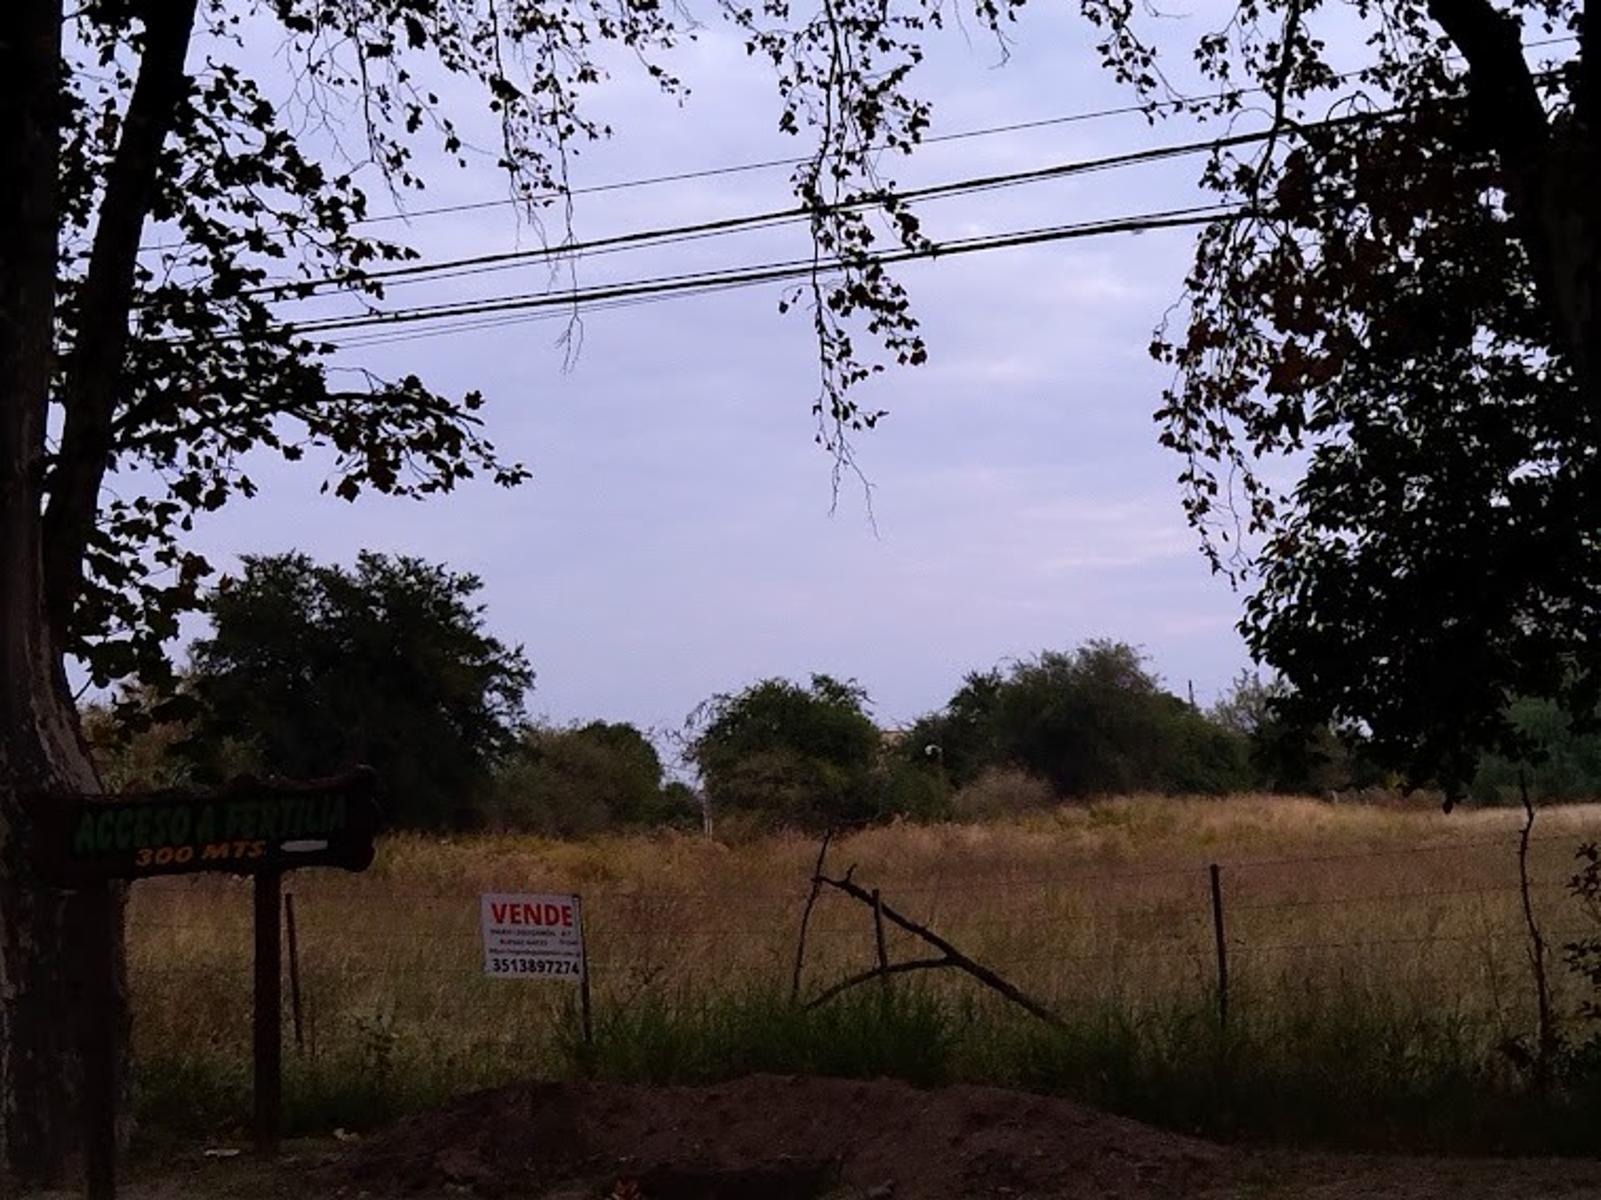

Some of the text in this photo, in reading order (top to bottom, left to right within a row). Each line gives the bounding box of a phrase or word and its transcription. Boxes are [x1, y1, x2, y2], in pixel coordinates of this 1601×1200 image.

[74, 807, 191, 852] ACCESO
[196, 804, 215, 842] A
[136, 841, 266, 867] 300 MTS
[492, 903, 572, 927] VENDE
[493, 959, 579, 974] 3513897274
